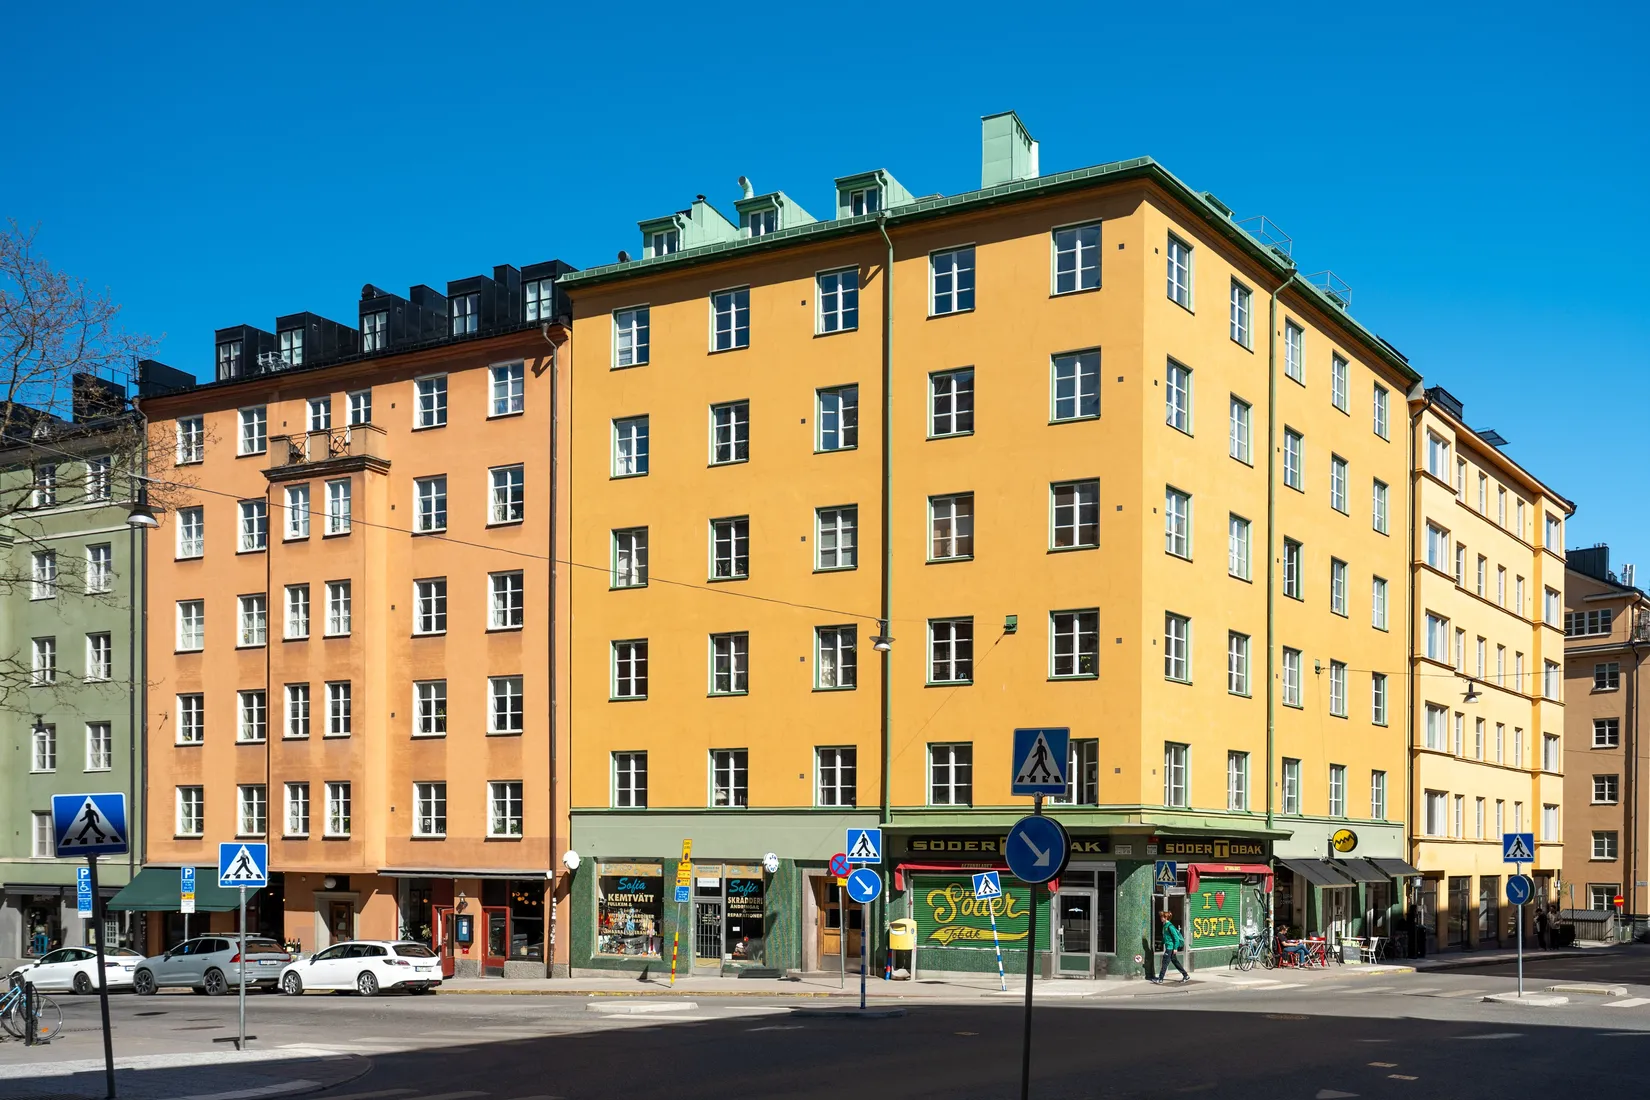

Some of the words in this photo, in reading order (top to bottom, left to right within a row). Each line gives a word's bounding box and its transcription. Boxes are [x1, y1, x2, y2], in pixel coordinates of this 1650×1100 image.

[913, 840, 996, 851] SÖDER
[1165, 842, 1213, 854] SÖDER
[80, 869, 89, 879] P
[184, 868, 193, 879] P
[617, 877, 647, 894] Sofia
[728, 879, 759, 896] Sofia
[607, 892, 655, 903] KEMTVÄTT
[727, 896, 763, 905] SKRÄDDERI
[1202, 892, 1212, 909] I
[943, 926, 981, 941] Tobak
[1193, 917, 1238, 938] SOFIA
